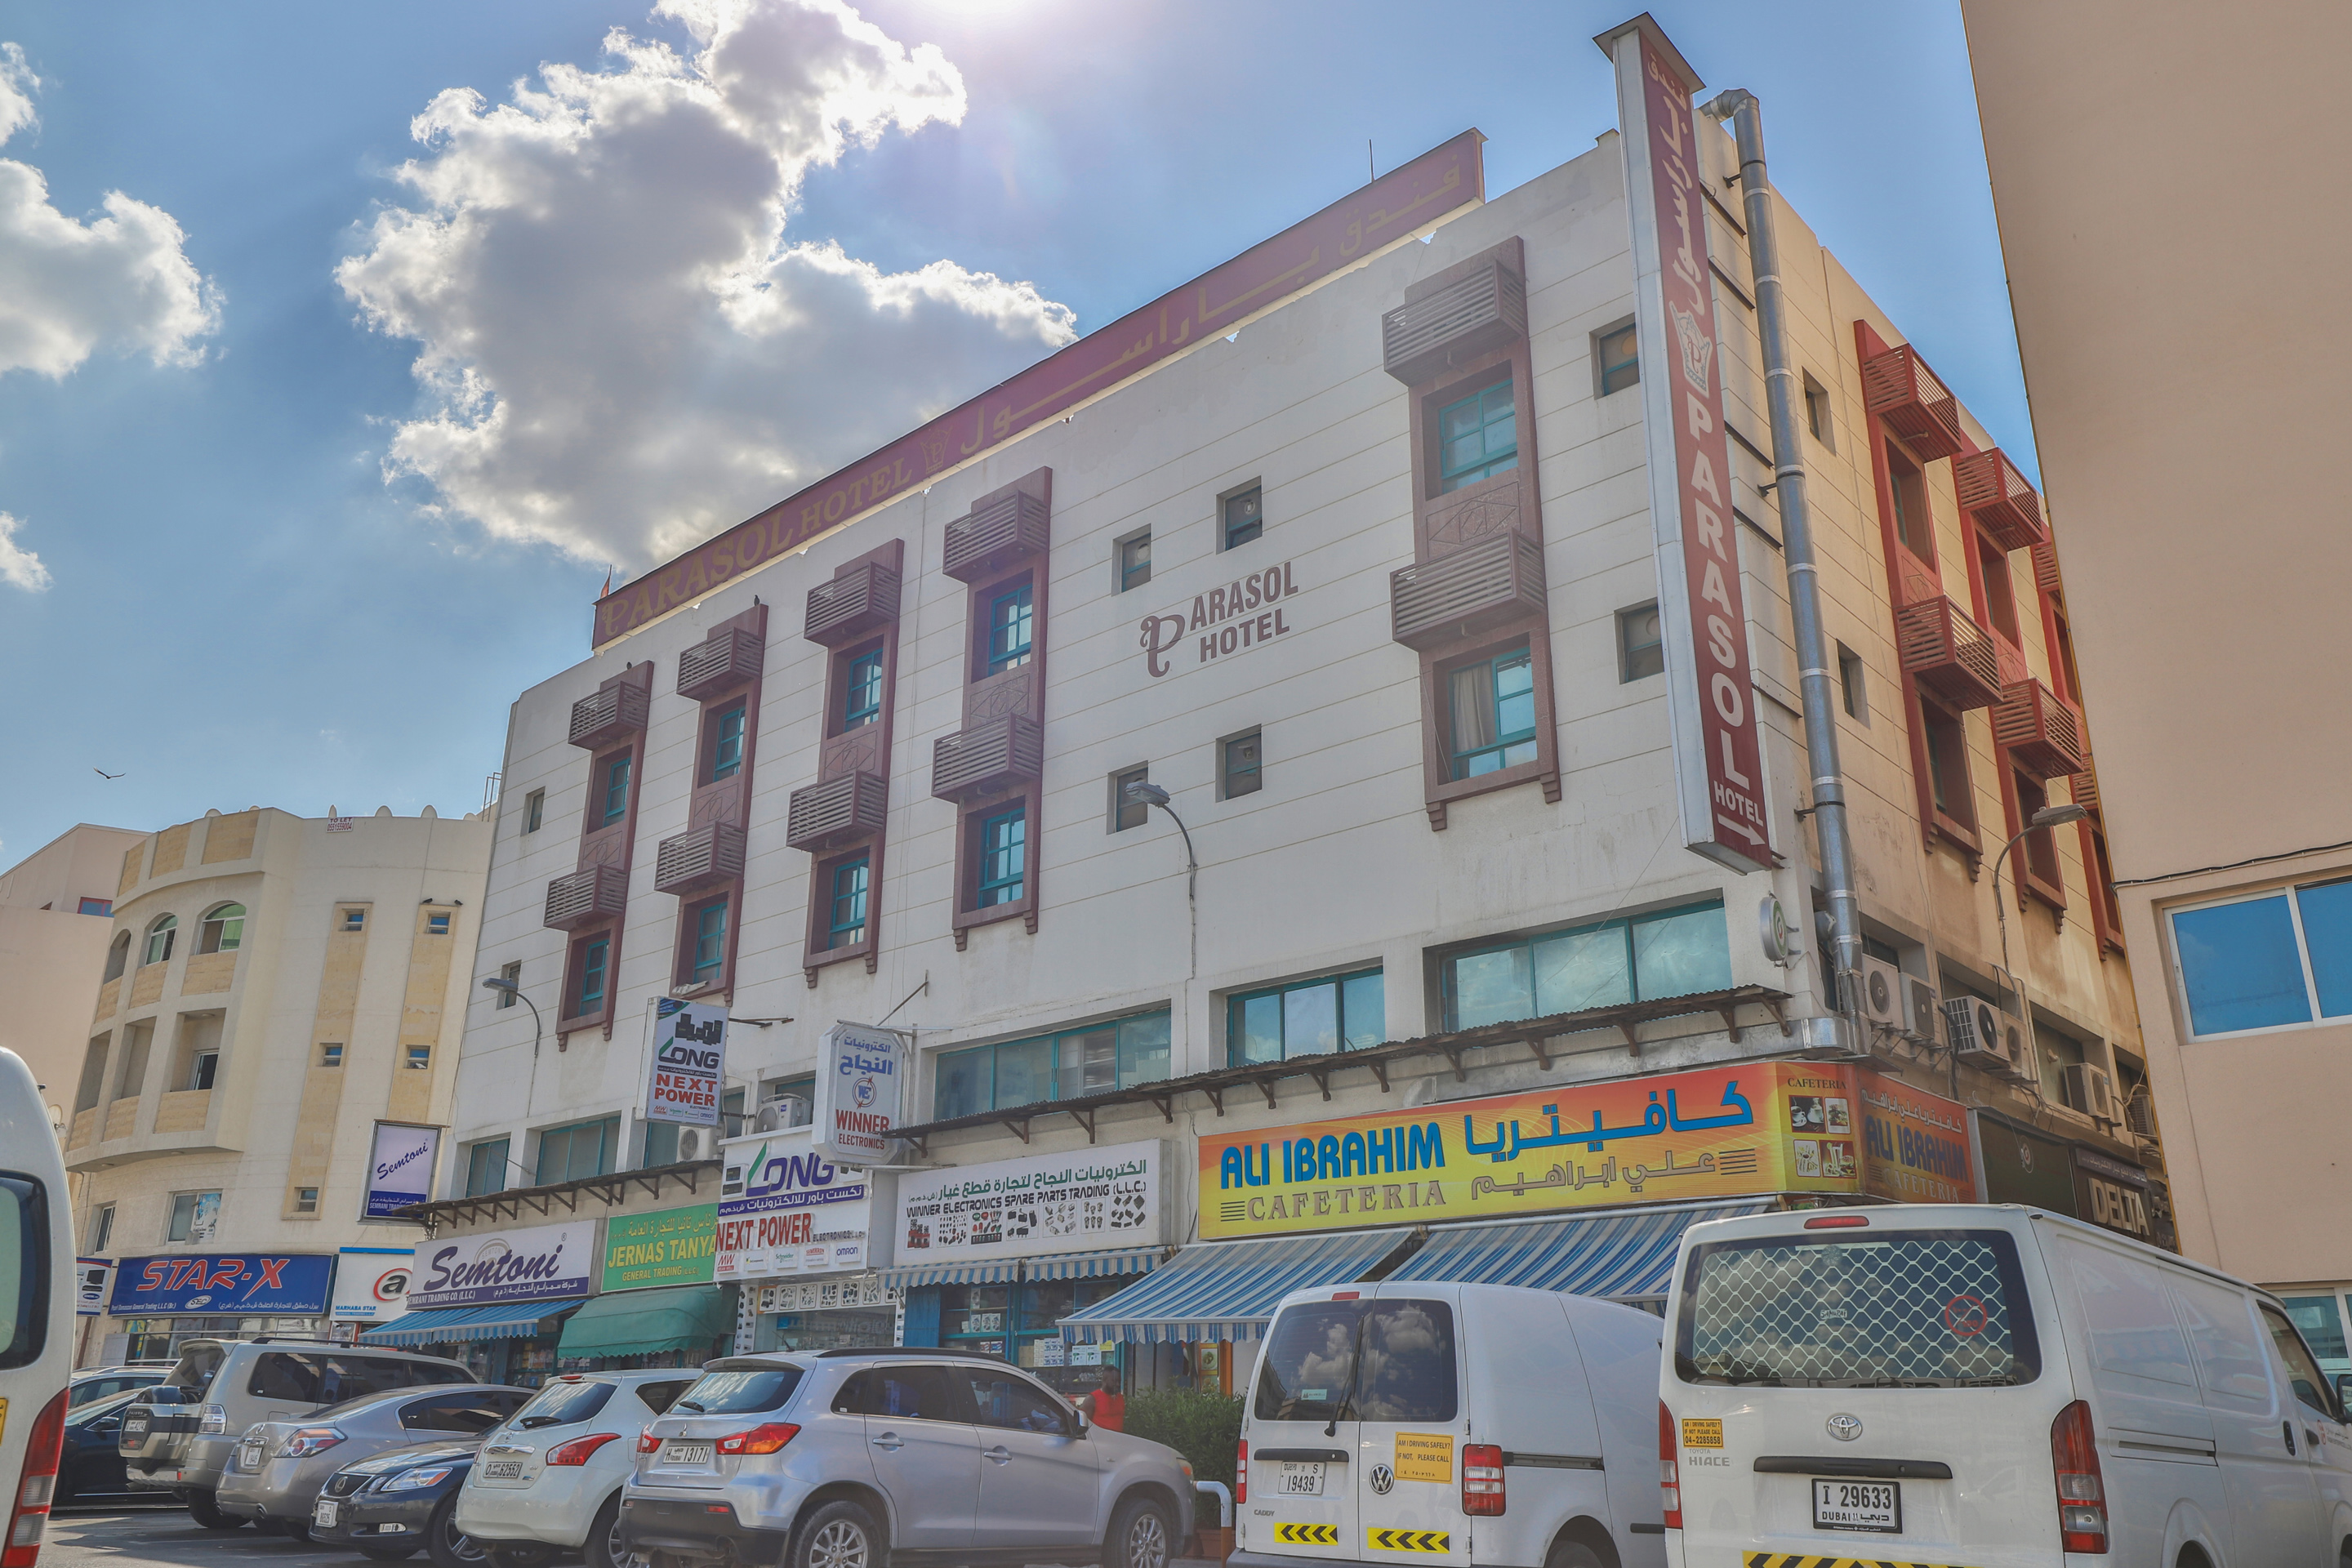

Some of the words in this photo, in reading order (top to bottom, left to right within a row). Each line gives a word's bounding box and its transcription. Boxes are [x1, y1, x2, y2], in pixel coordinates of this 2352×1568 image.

[1648, 53, 1688, 112] فندق
[1339, 155, 1461, 256] فندق
[1659, 95, 1705, 316] باراسول
[960, 245, 1320, 454] باراسول
[602, 510, 793, 637] PARASOL
[799, 457, 912, 538] HOTEL
[1686, 392, 1750, 791] PARASOL
[1200, 608, 1290, 663] HOTEL
[1714, 779, 1764, 828] HOTEL
[658, 1036, 719, 1069] LONG
[844, 1036, 891, 1054] الكترونيات
[840, 1054, 893, 1076] النجاح
[656, 1073, 717, 1093] NEXT
[858, 1085, 871, 1099] WE
[1788, 1077, 1846, 1089] CAFETERIA
[654, 1087, 715, 1107] POWER
[1861, 1089, 1898, 1116] ابراهيم
[835, 1108, 889, 1134] WINNER
[1898, 1099, 1919, 1123] علي
[1918, 1103, 1962, 1134] كافيتريا
[1464, 1080, 1753, 1163] كافيتريا
[838, 1133, 885, 1150] ELECTRONICS
[1865, 1115, 1895, 1162] ALI
[1896, 1124, 1969, 1183] IBRAHIM
[376, 1142, 429, 1181] Semtoni
[1220, 1143, 1270, 1189] ALI
[1282, 1121, 1446, 1183] IBRAHIM
[746, 1140, 835, 1197] LONG
[1075, 1160, 1146, 1183] الكترونيات
[1472, 1156, 1616, 1200] ابراهيم
[1622, 1151, 1716, 1193] علي
[962, 1179, 991, 1199] قطع
[993, 1174, 1030, 1193] لتجارة
[1033, 1169, 1071, 1190] النجاح
[1882, 1167, 1960, 1204] CAFETERIA
[746, 1193, 805, 1211] للالكترونيات
[806, 1193, 824, 1205] باور
[826, 1186, 862, 1200] نكست
[906, 1204, 941, 1218] WINNER
[943, 1196, 1002, 1214] ELECTRONICS
[1004, 1192, 1035, 1208] SPARE
[1037, 1189, 1067, 1204] PARTS
[1068, 1184, 1109, 1200] TRADING
[938, 1183, 960, 1201] غيار
[1246, 1180, 1446, 1222] CAFETERIA
[2087, 1177, 2150, 1236] DELTA
[628, 1220, 648, 1236] العامة
[650, 1217, 675, 1237] للتجارة
[715, 1219, 755, 1252] NEXT
[757, 1213, 812, 1248] POWER
[813, 1230, 850, 1242] ELECTRONICS
[608, 1241, 665, 1268] JERNAS
[669, 1234, 716, 1261] TANYA
[718, 1253, 735, 1265] MW
[775, 1252, 794, 1263] Schneider
[836, 1246, 858, 1256] OMRON
[424, 1244, 561, 1290] Semtoni
[622, 1269, 652, 1281] GENERAL
[653, 1266, 682, 1278] TRADING
[136, 1259, 290, 1302] STAR-X
[508, 1282, 534, 1295] التجارية
[533, 1281, 561, 1294] سمراني
[561, 1281, 578, 1290] شركة
[427, 1292, 450, 1303] TRADING
[450, 1291, 458, 1300] CO.
[1409, 1440, 1429, 1448] DRIVING
[1430, 1441, 1450, 1450] SAFELY?
[1685, 1436, 1721, 1445] 04-2285858
[684, 1447, 708, 1462] 13171
[1436, 1454, 1450, 1463] CALL
[1688, 1456, 1731, 1467] HIACE
[1312, 1463, 1319, 1474] S
[1286, 1475, 1315, 1492] 19439
[1823, 1485, 1830, 1505] I
[1840, 1485, 1892, 1510] 29633
[1254, 1508, 1275, 1517] CADDY
[1822, 1511, 1851, 1521] DUBAI
[1860, 1513, 1890, 1524] دبي
